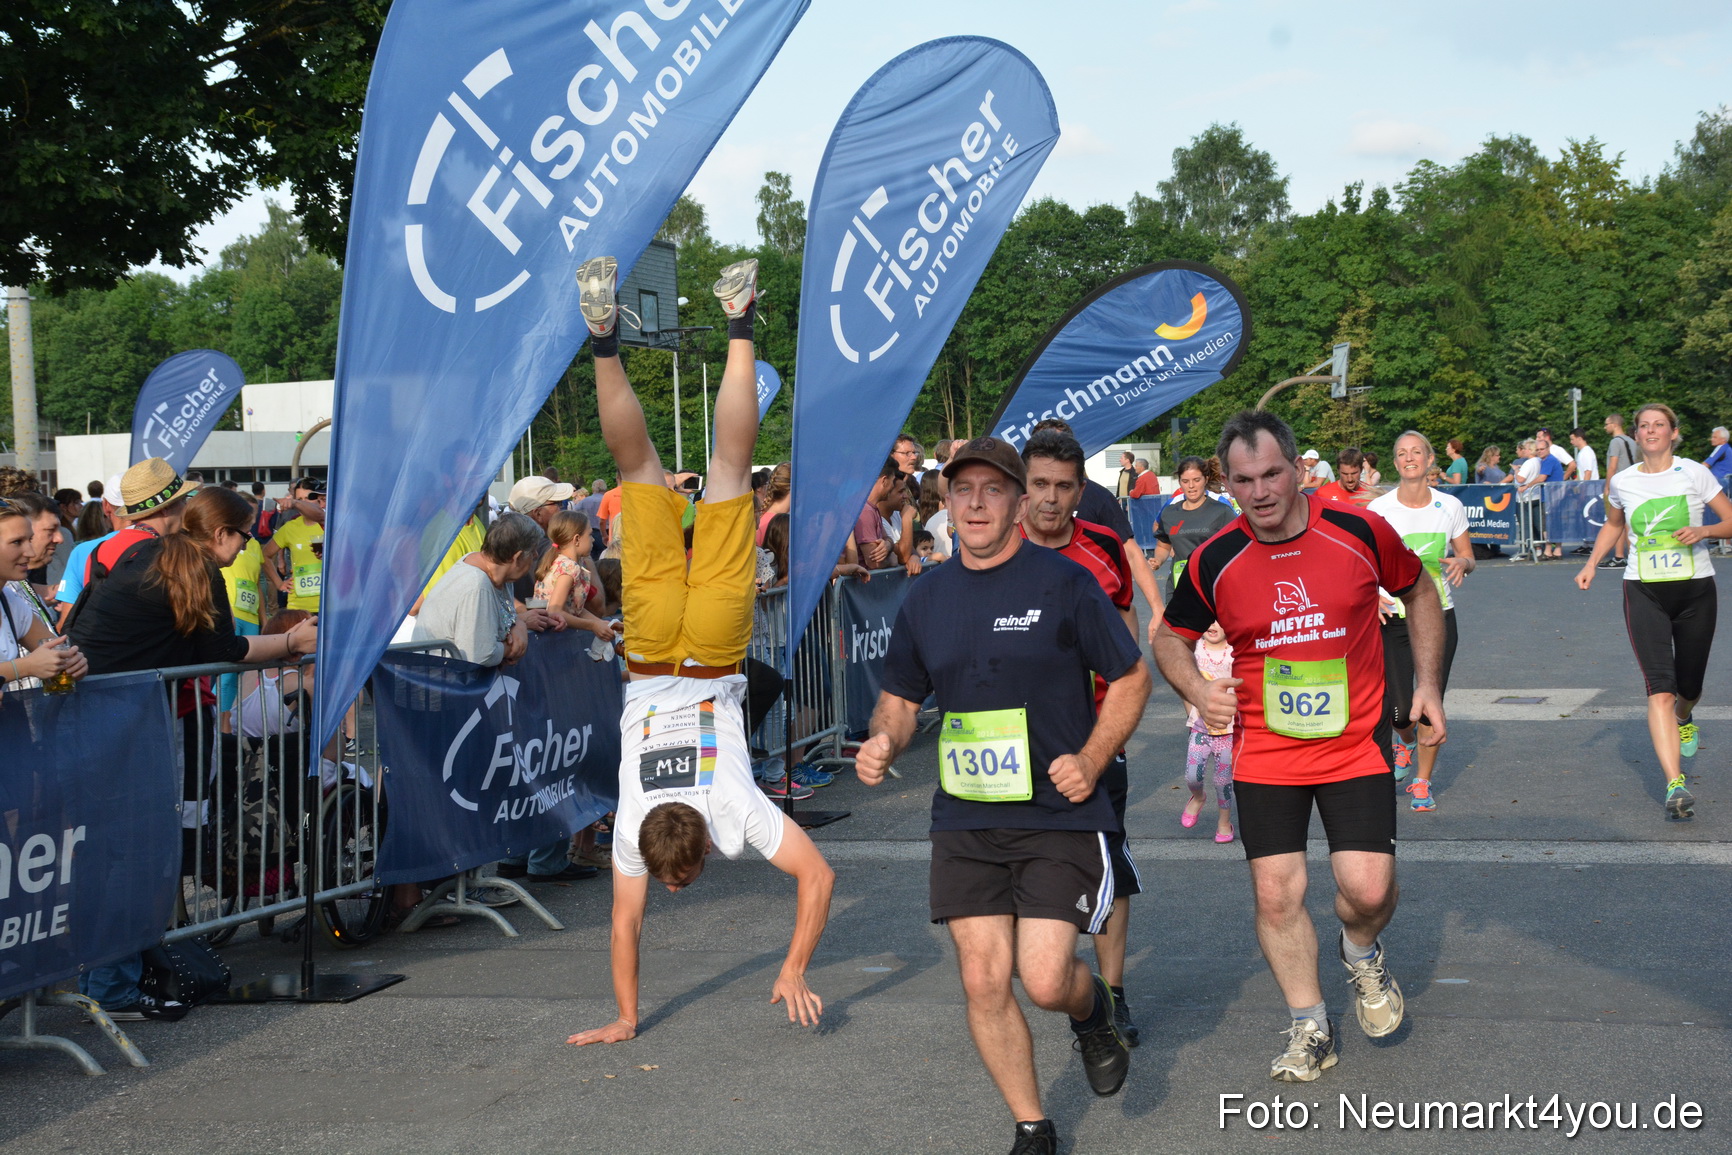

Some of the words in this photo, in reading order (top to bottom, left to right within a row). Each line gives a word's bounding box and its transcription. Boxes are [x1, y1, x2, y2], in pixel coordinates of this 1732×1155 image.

[863, 89, 1002, 323] Fischer
[914, 133, 1019, 319] AUTOMOBILE
[1113, 378, 1156, 407] Druck
[1156, 362, 1184, 382] und
[1184, 331, 1235, 367] Medien
[157, 367, 219, 449] Fischer
[180, 382, 227, 448] AUTOMOBILE
[1486, 519, 1510, 528] Medien
[1271, 550, 1302, 560] STANNO
[1649, 552, 1683, 569] 112
[300, 576, 321, 588] 652
[993, 614, 1033, 627] reindl
[1270, 613, 1325, 635] MEYER
[852, 616, 894, 664] Frisch
[1255, 629, 1320, 649] Fördertechnik
[1322, 627, 1347, 639] GmbH
[1278, 691, 1331, 717] 962
[662, 721, 696, 730] HANDWERK
[670, 713, 696, 721] WOHNEN
[480, 718, 593, 791] Fischer
[946, 746, 1021, 776] 1304
[656, 755, 690, 777] RW
